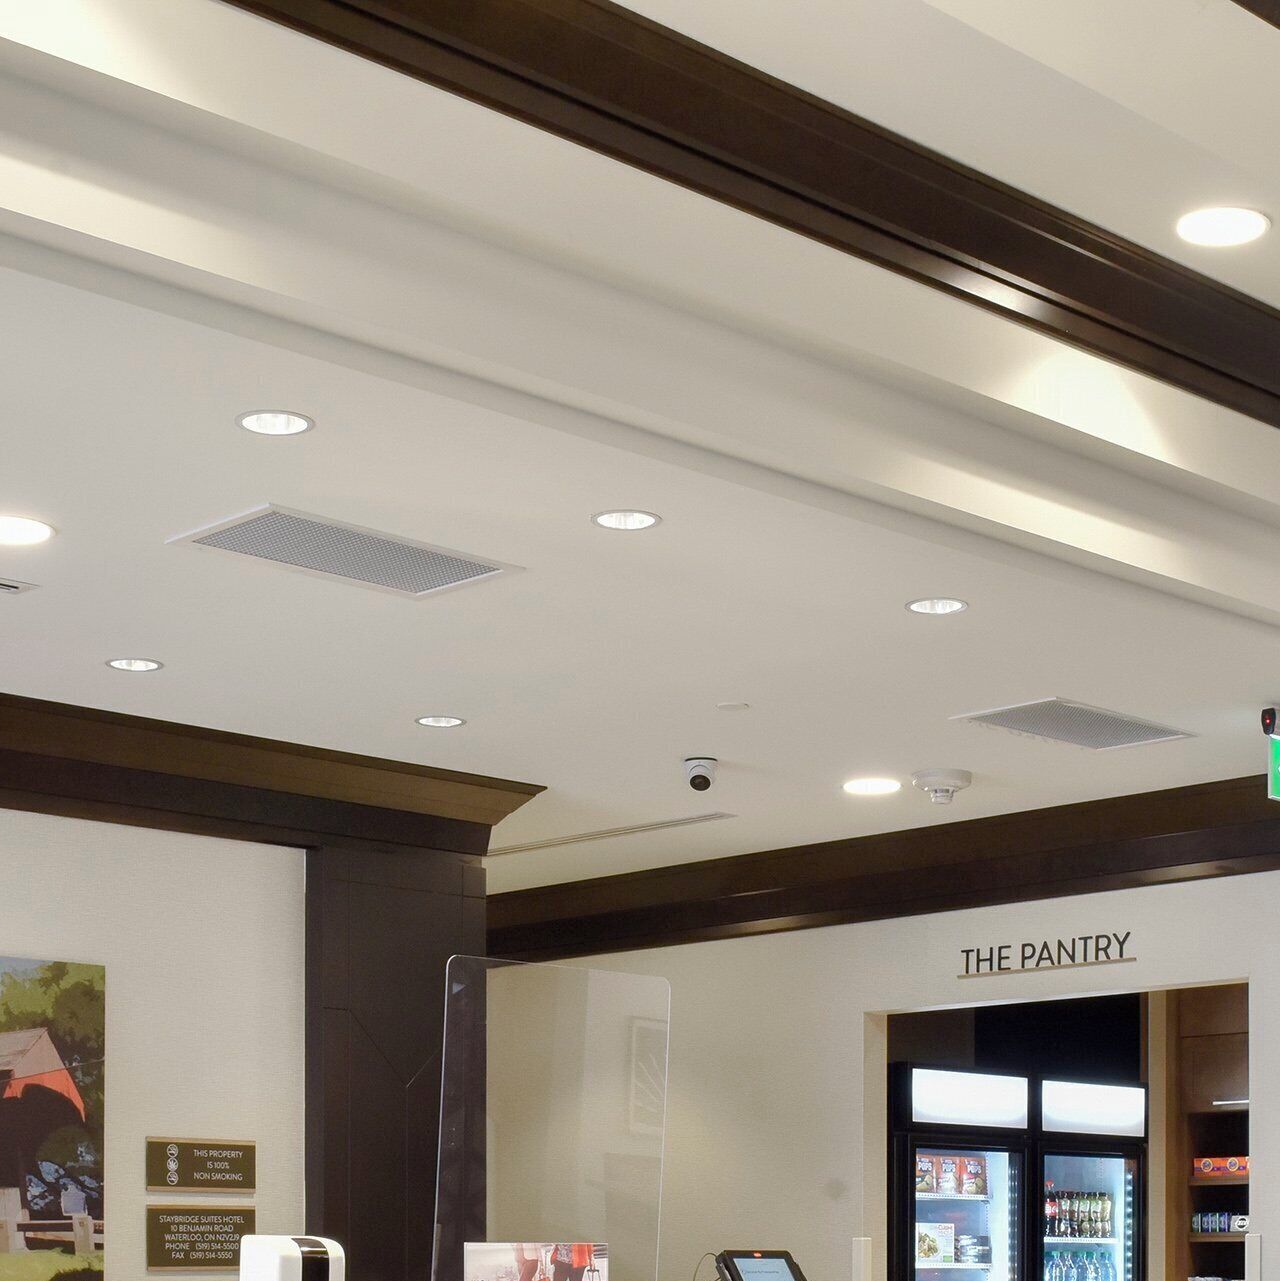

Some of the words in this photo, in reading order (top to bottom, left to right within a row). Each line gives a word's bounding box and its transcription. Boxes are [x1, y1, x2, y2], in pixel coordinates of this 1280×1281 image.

[961, 945, 1011, 975] THE
[1021, 931, 1131, 969] PANTRY
[193, 1149, 208, 1157] THIS
[209, 1150, 243, 1158] PROPERTY
[207, 1161, 213, 1169] IS
[193, 1172, 210, 1180] NON
[211, 1173, 243, 1181] SMOKING
[159, 1215, 199, 1223] STAYBRIDGE
[164, 1234, 203, 1242] WATERLOO,
[165, 1242, 190, 1250] PHONE
[195, 1242, 210, 1250] (519)
[172, 1251, 185, 1259] FAX
[190, 1251, 205, 1259] (519)
